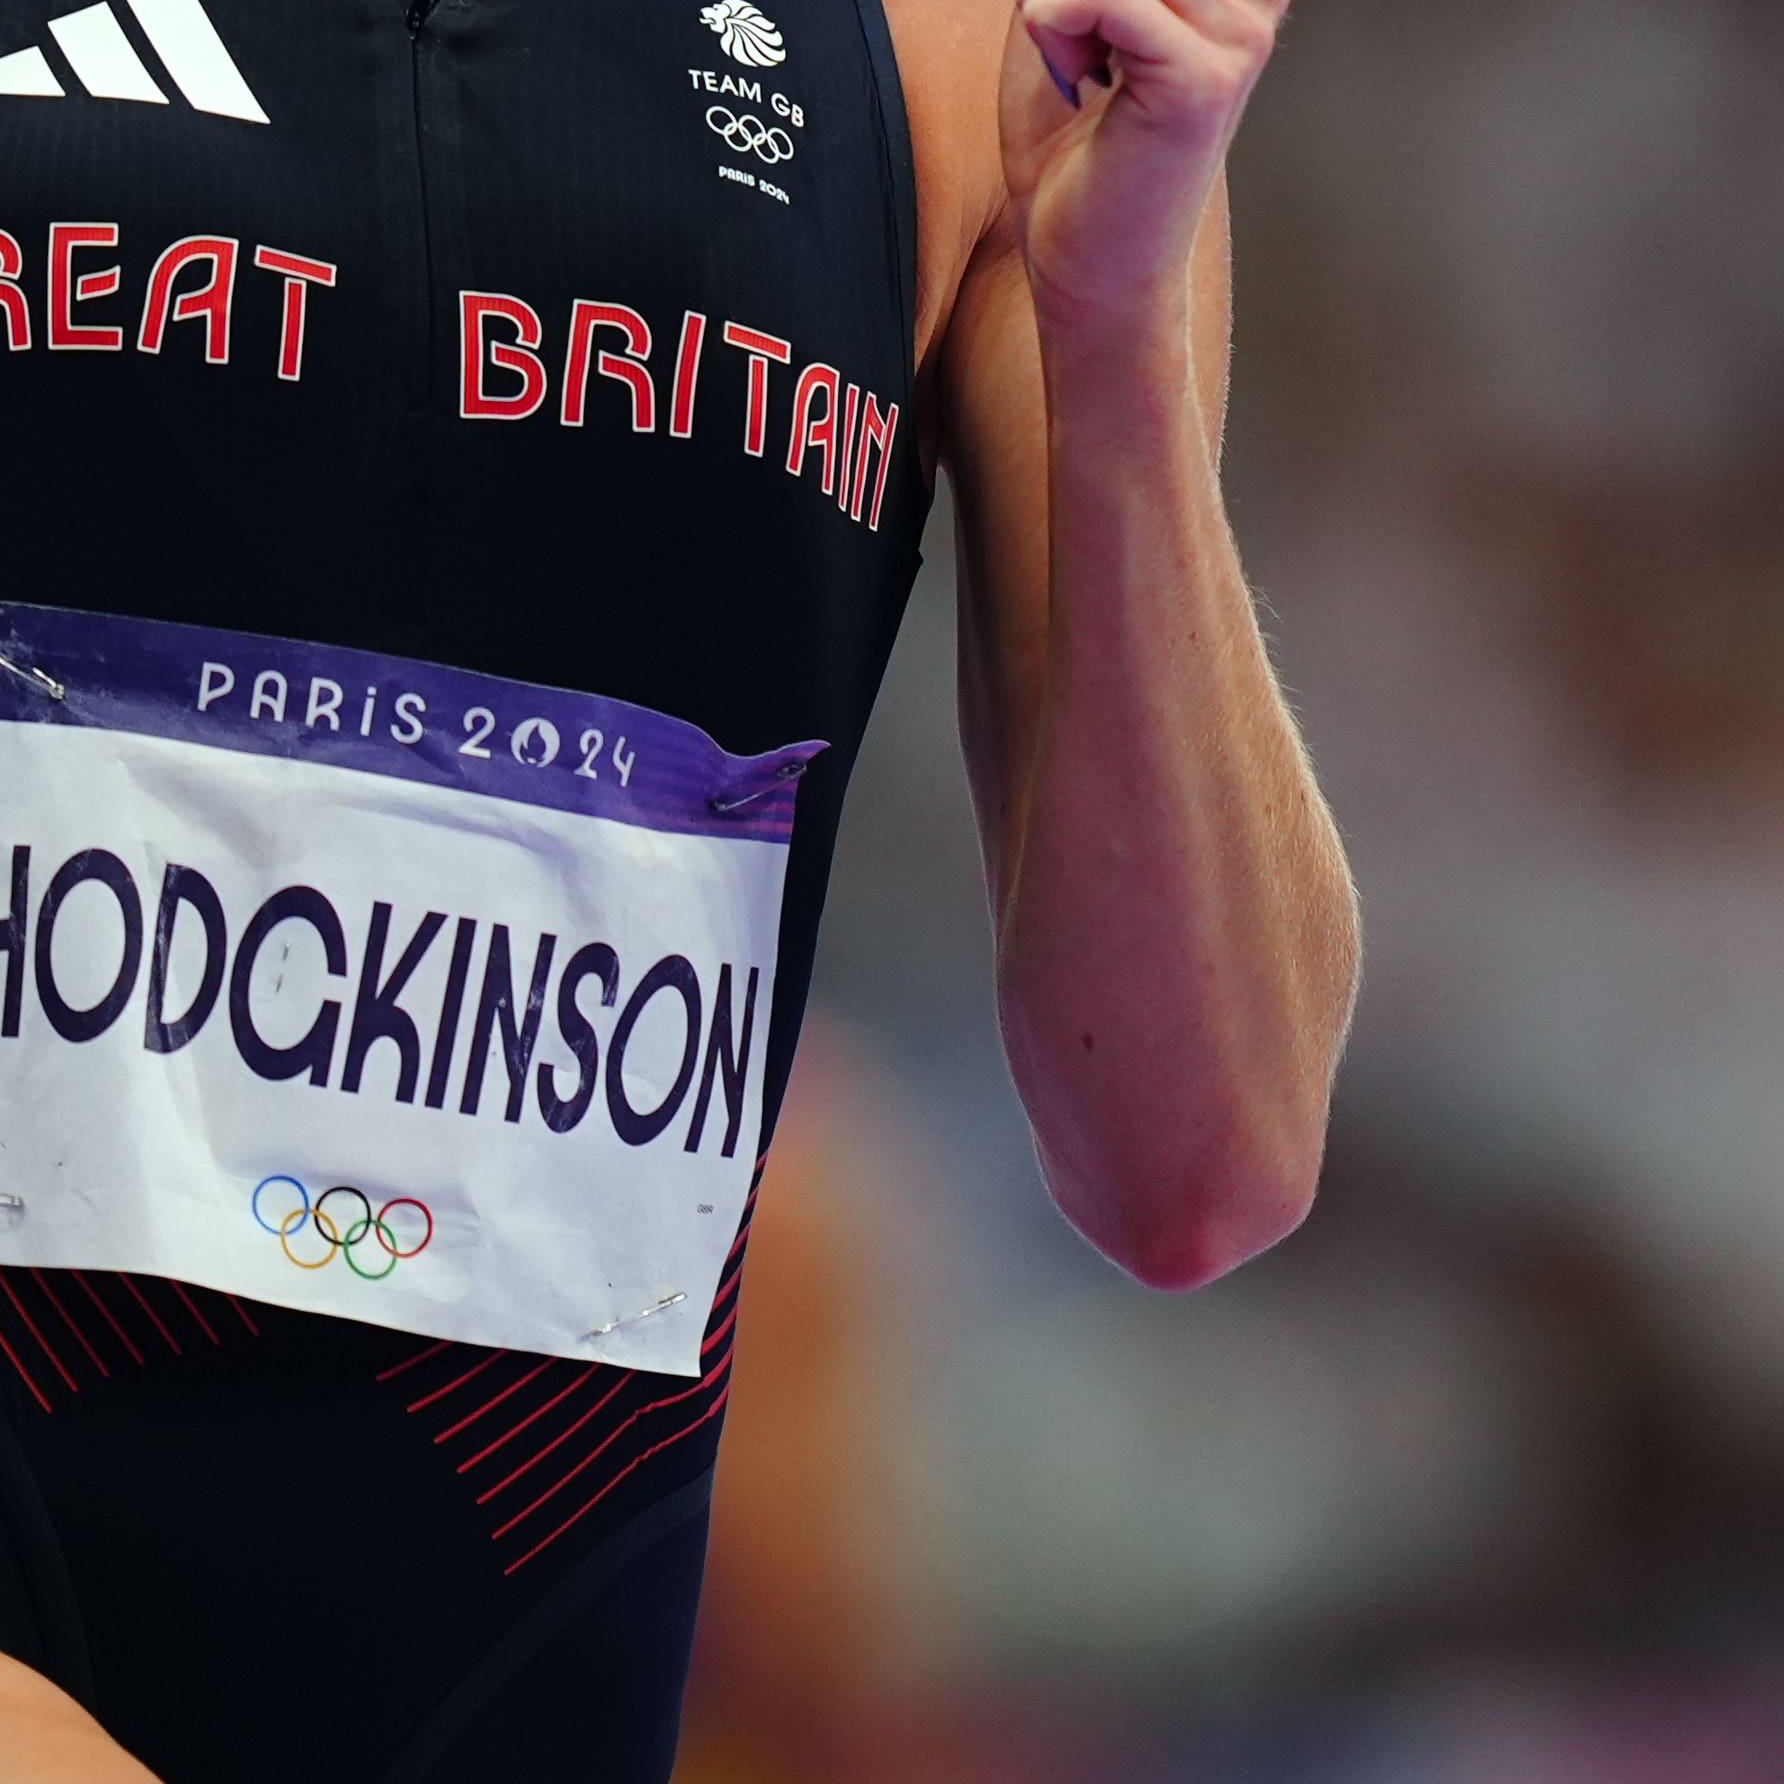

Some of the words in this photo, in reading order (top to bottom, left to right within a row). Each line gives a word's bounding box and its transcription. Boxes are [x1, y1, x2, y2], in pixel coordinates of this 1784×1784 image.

[688, 69, 762, 103] TEAM
[771, 93, 804, 127] GB
[759, 179, 790, 205] 2024
[459, 289, 900, 532] BRITAIN
[458, 707, 636, 787] 2024
